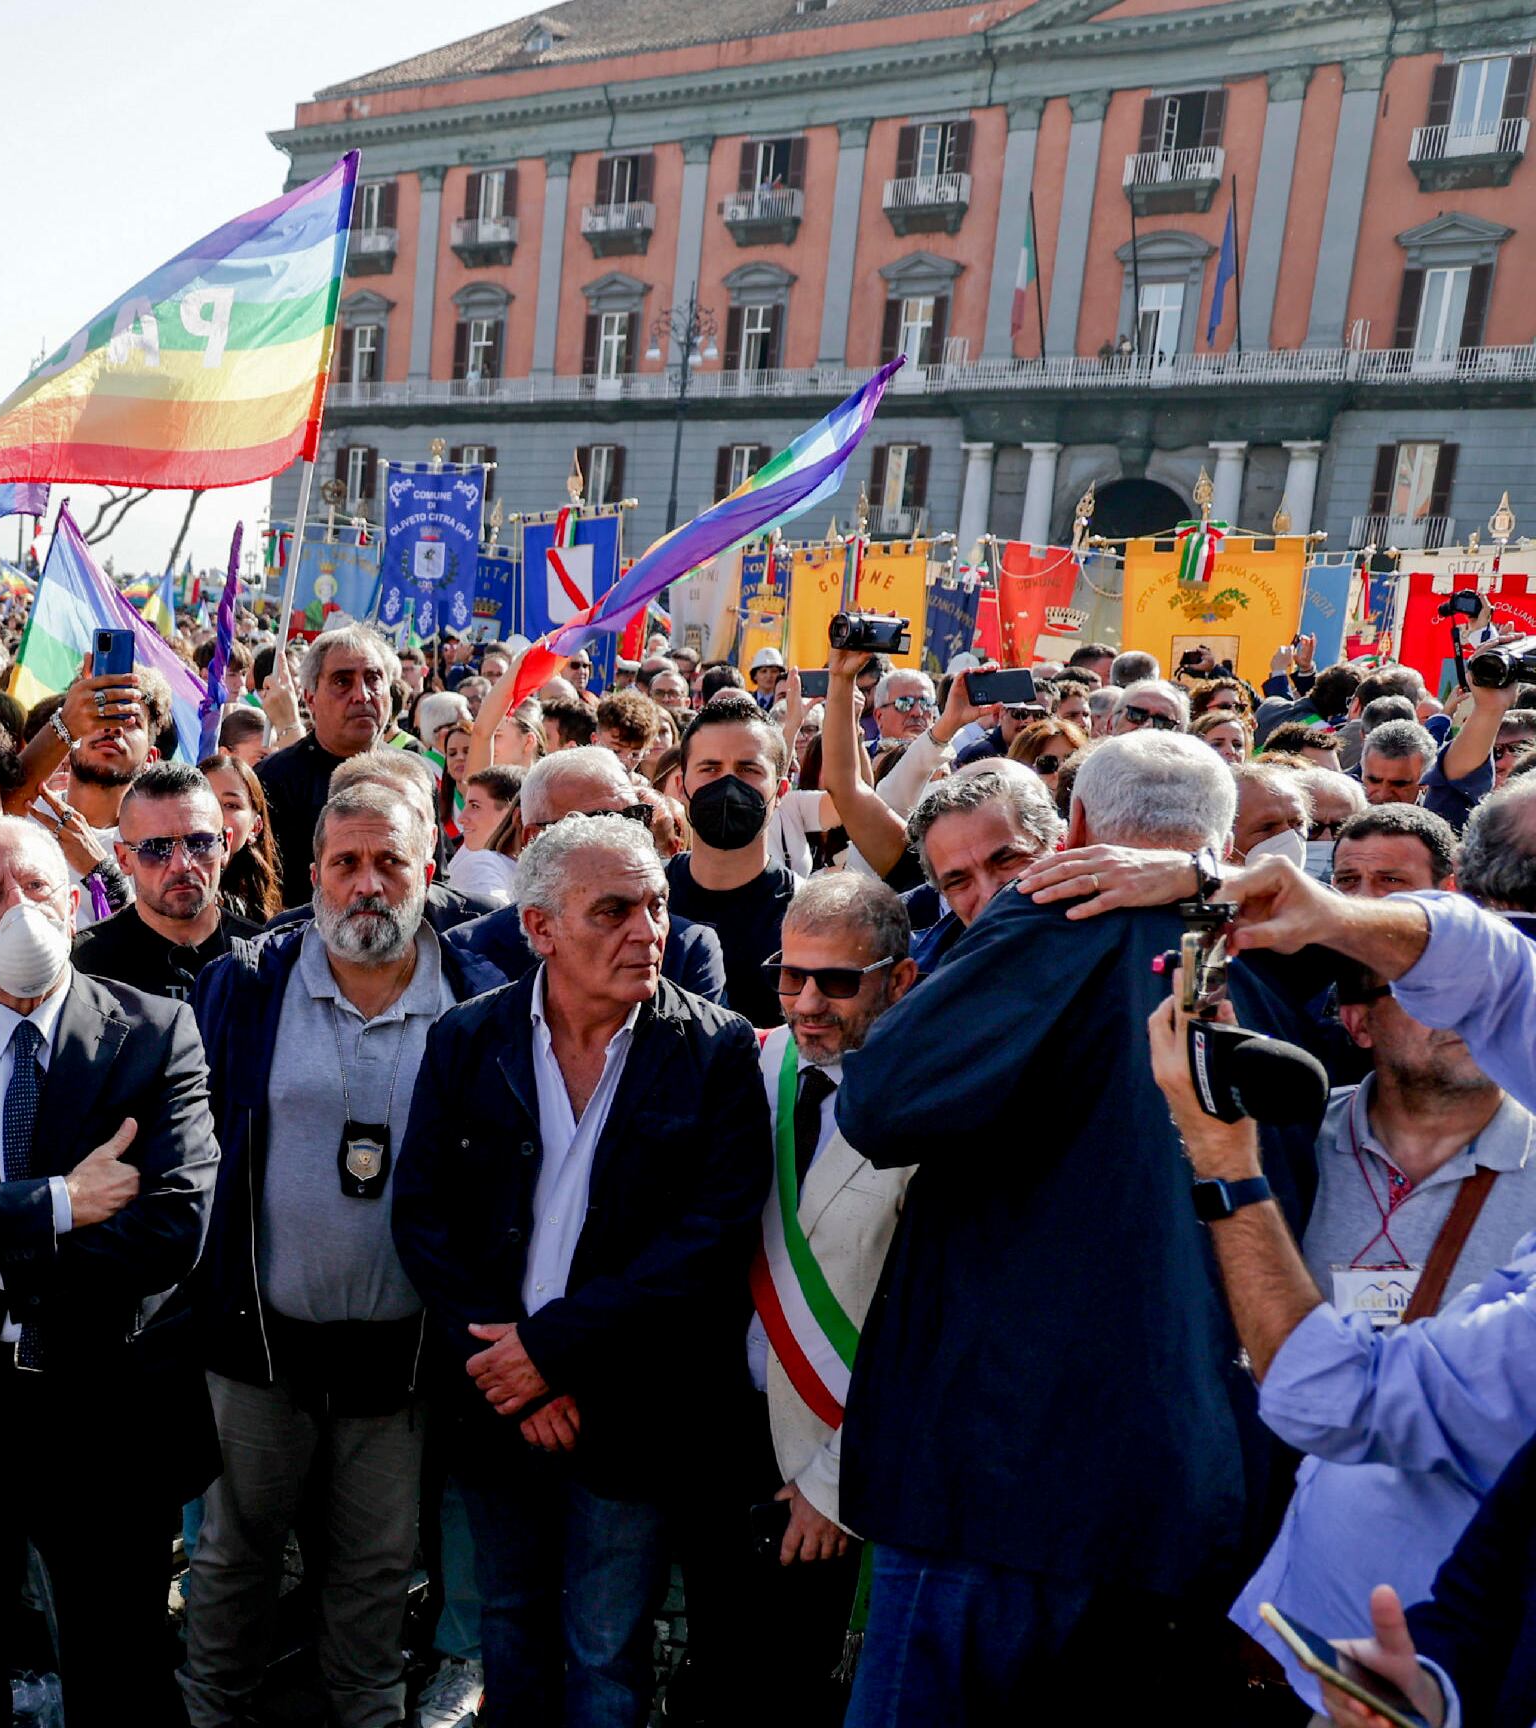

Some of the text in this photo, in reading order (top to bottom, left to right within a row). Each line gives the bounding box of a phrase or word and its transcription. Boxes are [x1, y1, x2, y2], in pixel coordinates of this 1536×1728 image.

[413, 490, 452, 500] COMUNE
[390, 513, 426, 536] OLIVETO
[428, 512, 465, 527] CITRA
